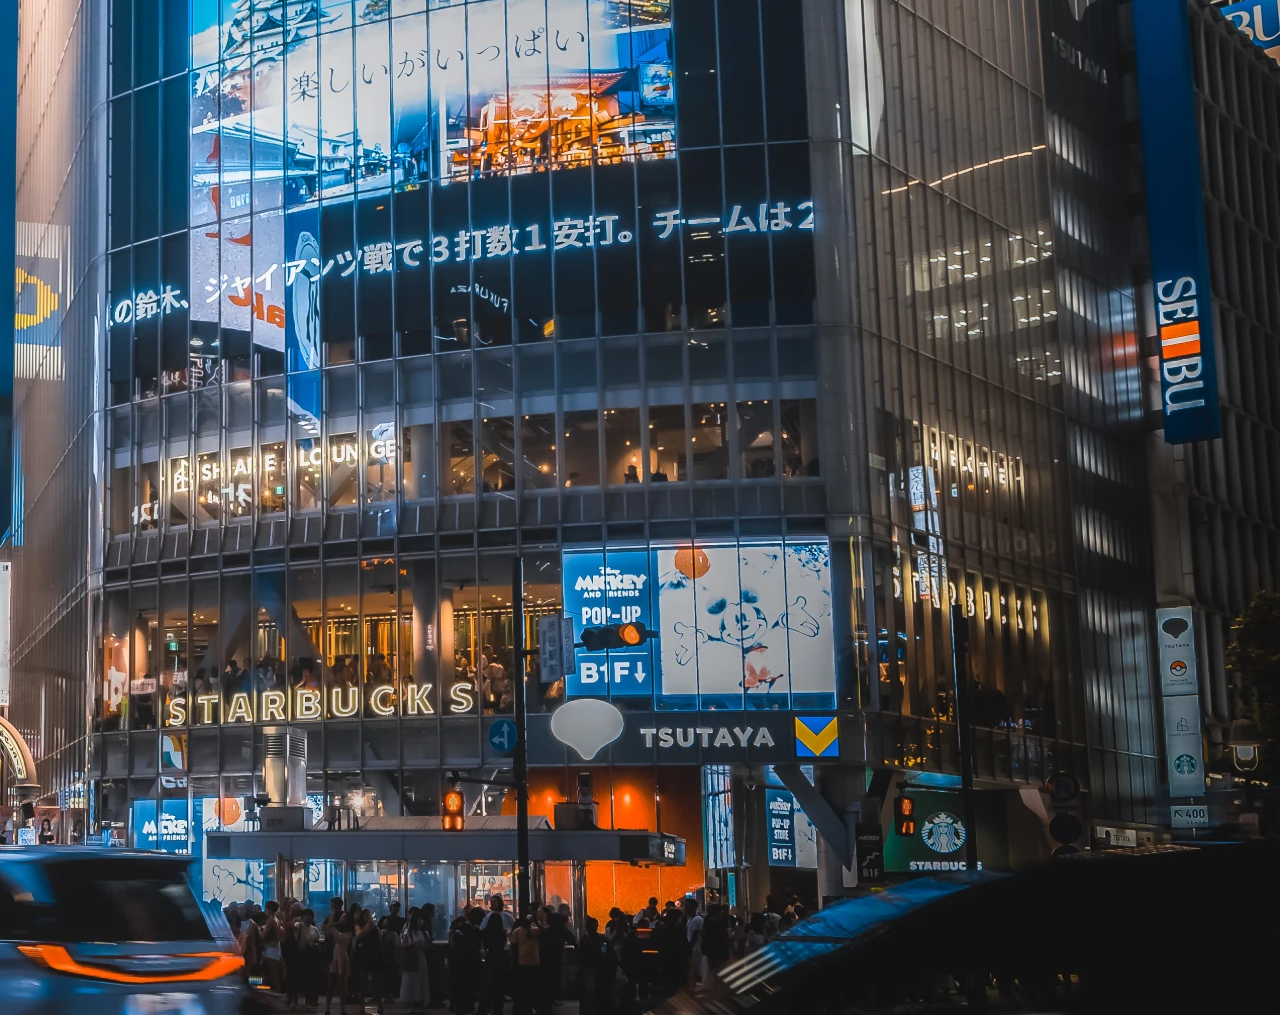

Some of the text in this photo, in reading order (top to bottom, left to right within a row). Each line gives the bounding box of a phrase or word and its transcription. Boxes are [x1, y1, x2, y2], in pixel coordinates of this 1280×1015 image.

[290, 26, 585, 103] 楽しいがいっぱい
[1157, 276, 1205, 416] SEIBU
[299, 440, 396, 468] LOUNGE
[574, 574, 648, 591] MICKEY
[583, 589, 640, 598] AND FRIENDS
[581, 606, 641, 624] POP-UP
[580, 662, 630, 683] B1F
[169, 682, 474, 726] STARBUCKS
[640, 727, 775, 748] TSUTAYA
[1185, 809, 1206, 819] 400
[772, 818, 790, 829] POP-UP
[774, 829, 789, 840] STORE
[772, 847, 788, 860] B1F
[862, 868, 879, 878] B1F
[910, 861, 983, 871] STARBUCS
